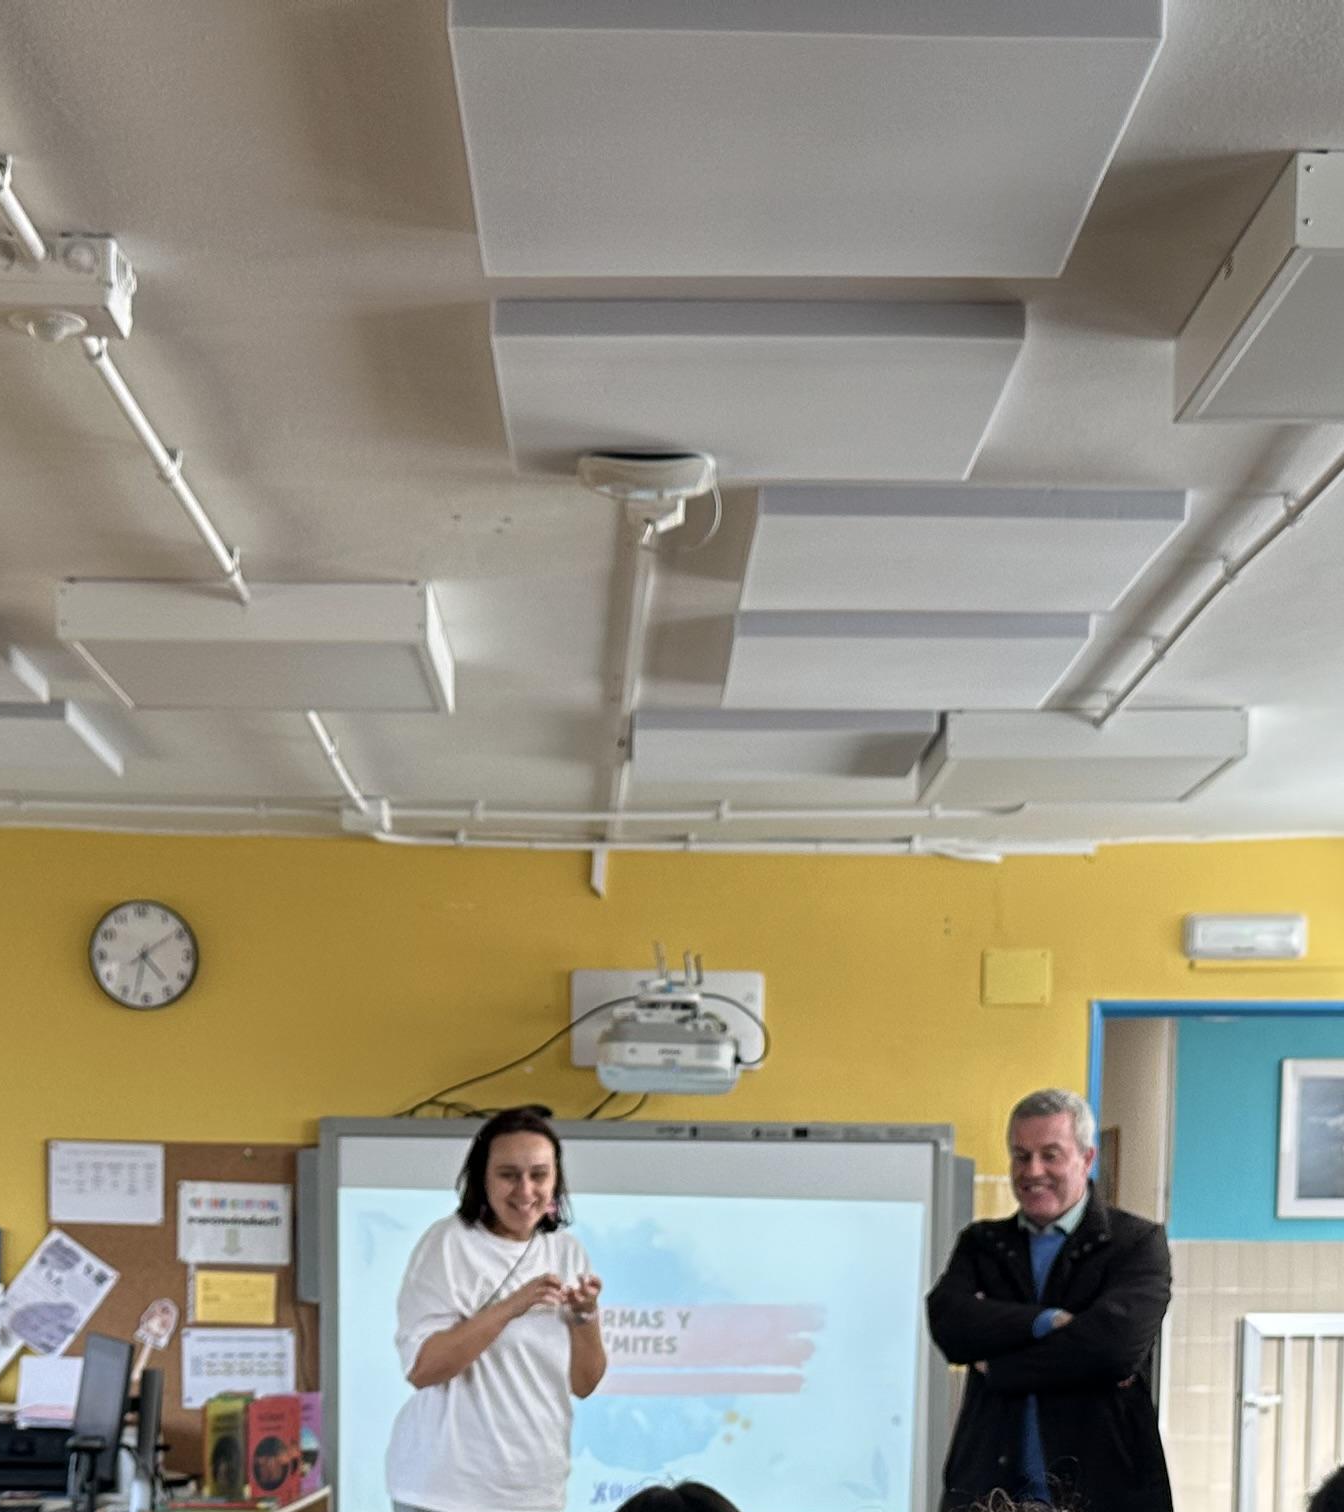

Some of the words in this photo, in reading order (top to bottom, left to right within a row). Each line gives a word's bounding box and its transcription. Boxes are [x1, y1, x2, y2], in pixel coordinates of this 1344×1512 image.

[601, 1309, 665, 1329] RMAS
[677, 1311, 691, 1328] Y
[604, 1333, 677, 1354] MITES
